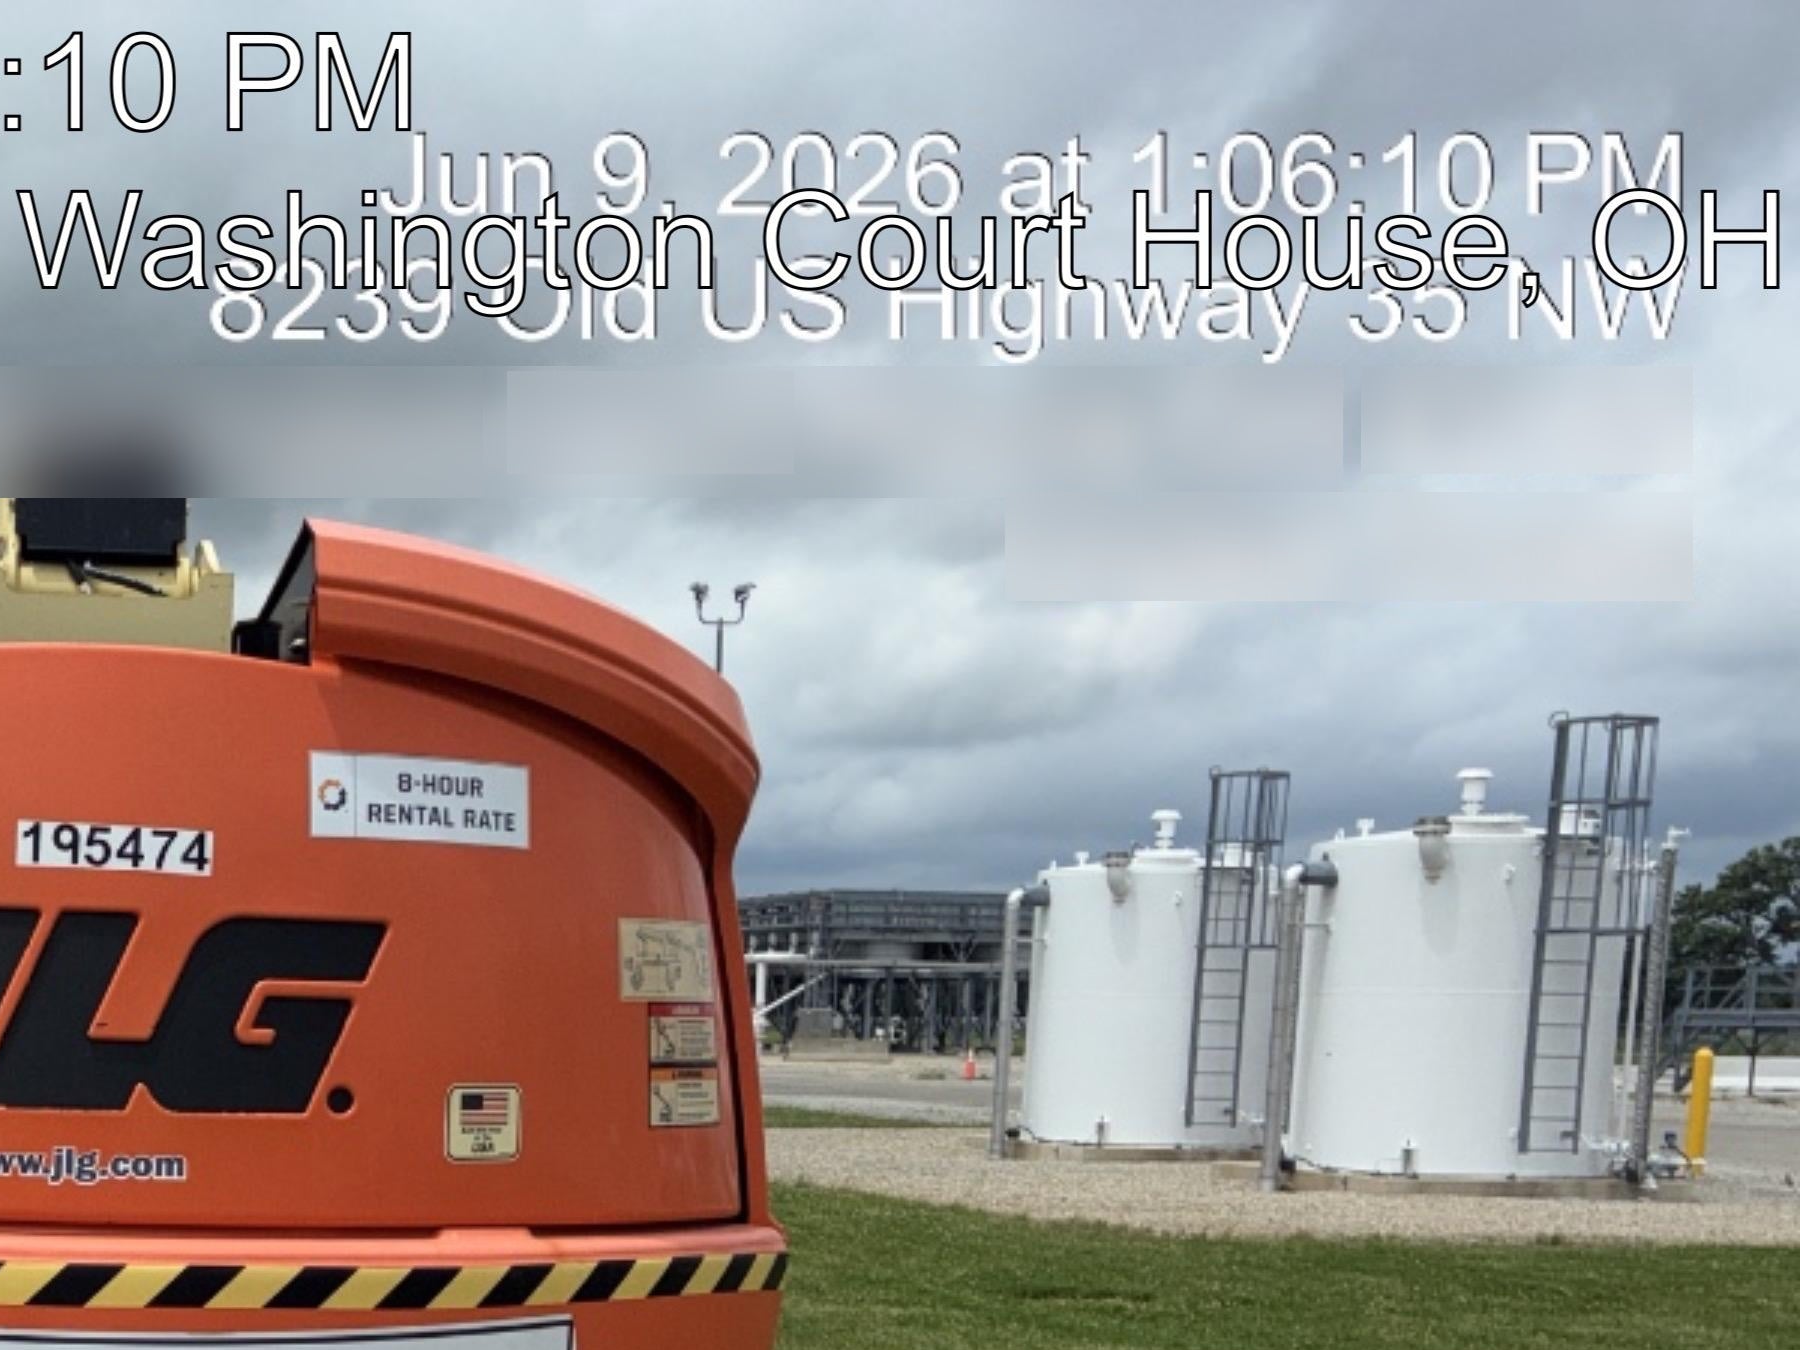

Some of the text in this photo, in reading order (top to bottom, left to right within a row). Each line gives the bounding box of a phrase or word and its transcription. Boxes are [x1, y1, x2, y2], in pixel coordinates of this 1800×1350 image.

[397, 772, 485, 798] 8-HOUR
[367, 804, 517, 832] RENTAL RATE
[21, 822, 209, 871] 195474
